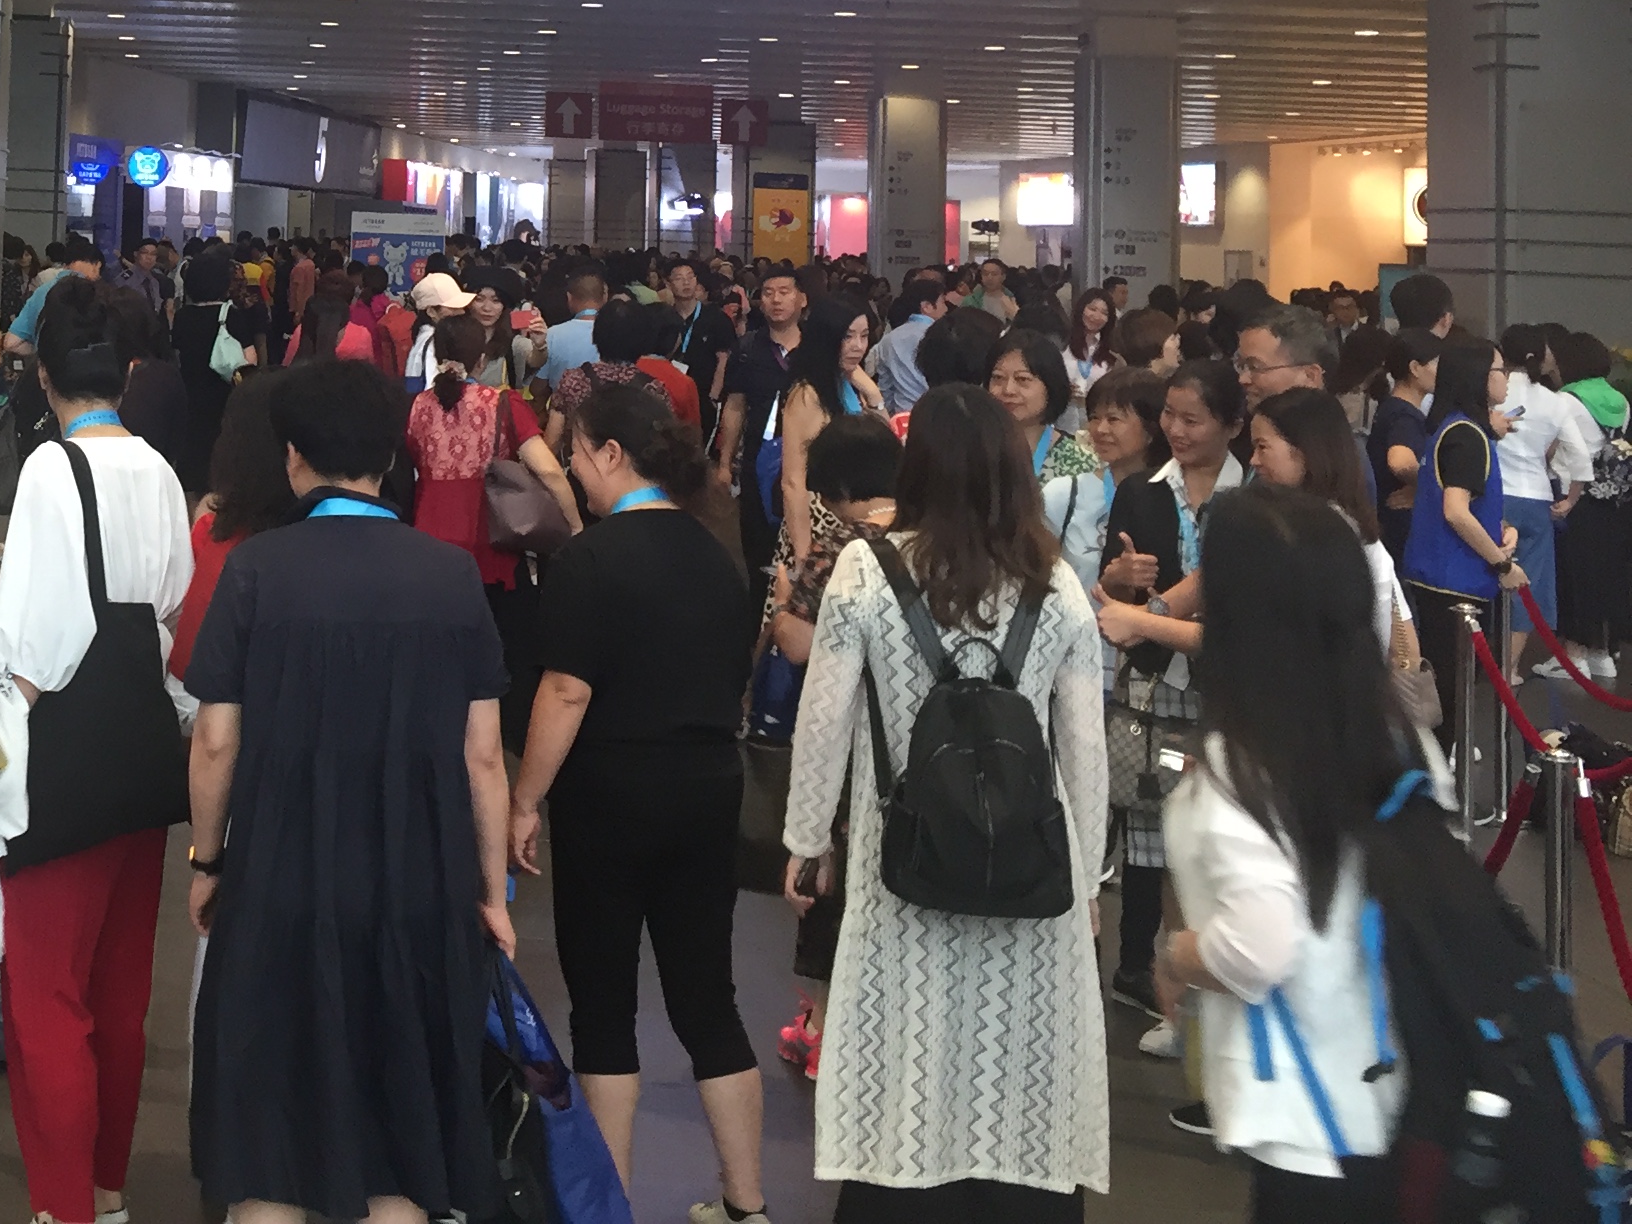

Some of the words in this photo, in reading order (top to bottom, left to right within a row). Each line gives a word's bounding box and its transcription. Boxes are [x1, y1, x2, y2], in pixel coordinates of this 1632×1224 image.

[606, 103, 655, 116] Luggage
[659, 104, 706, 117] Storage
[314, 116, 329, 183] 5
